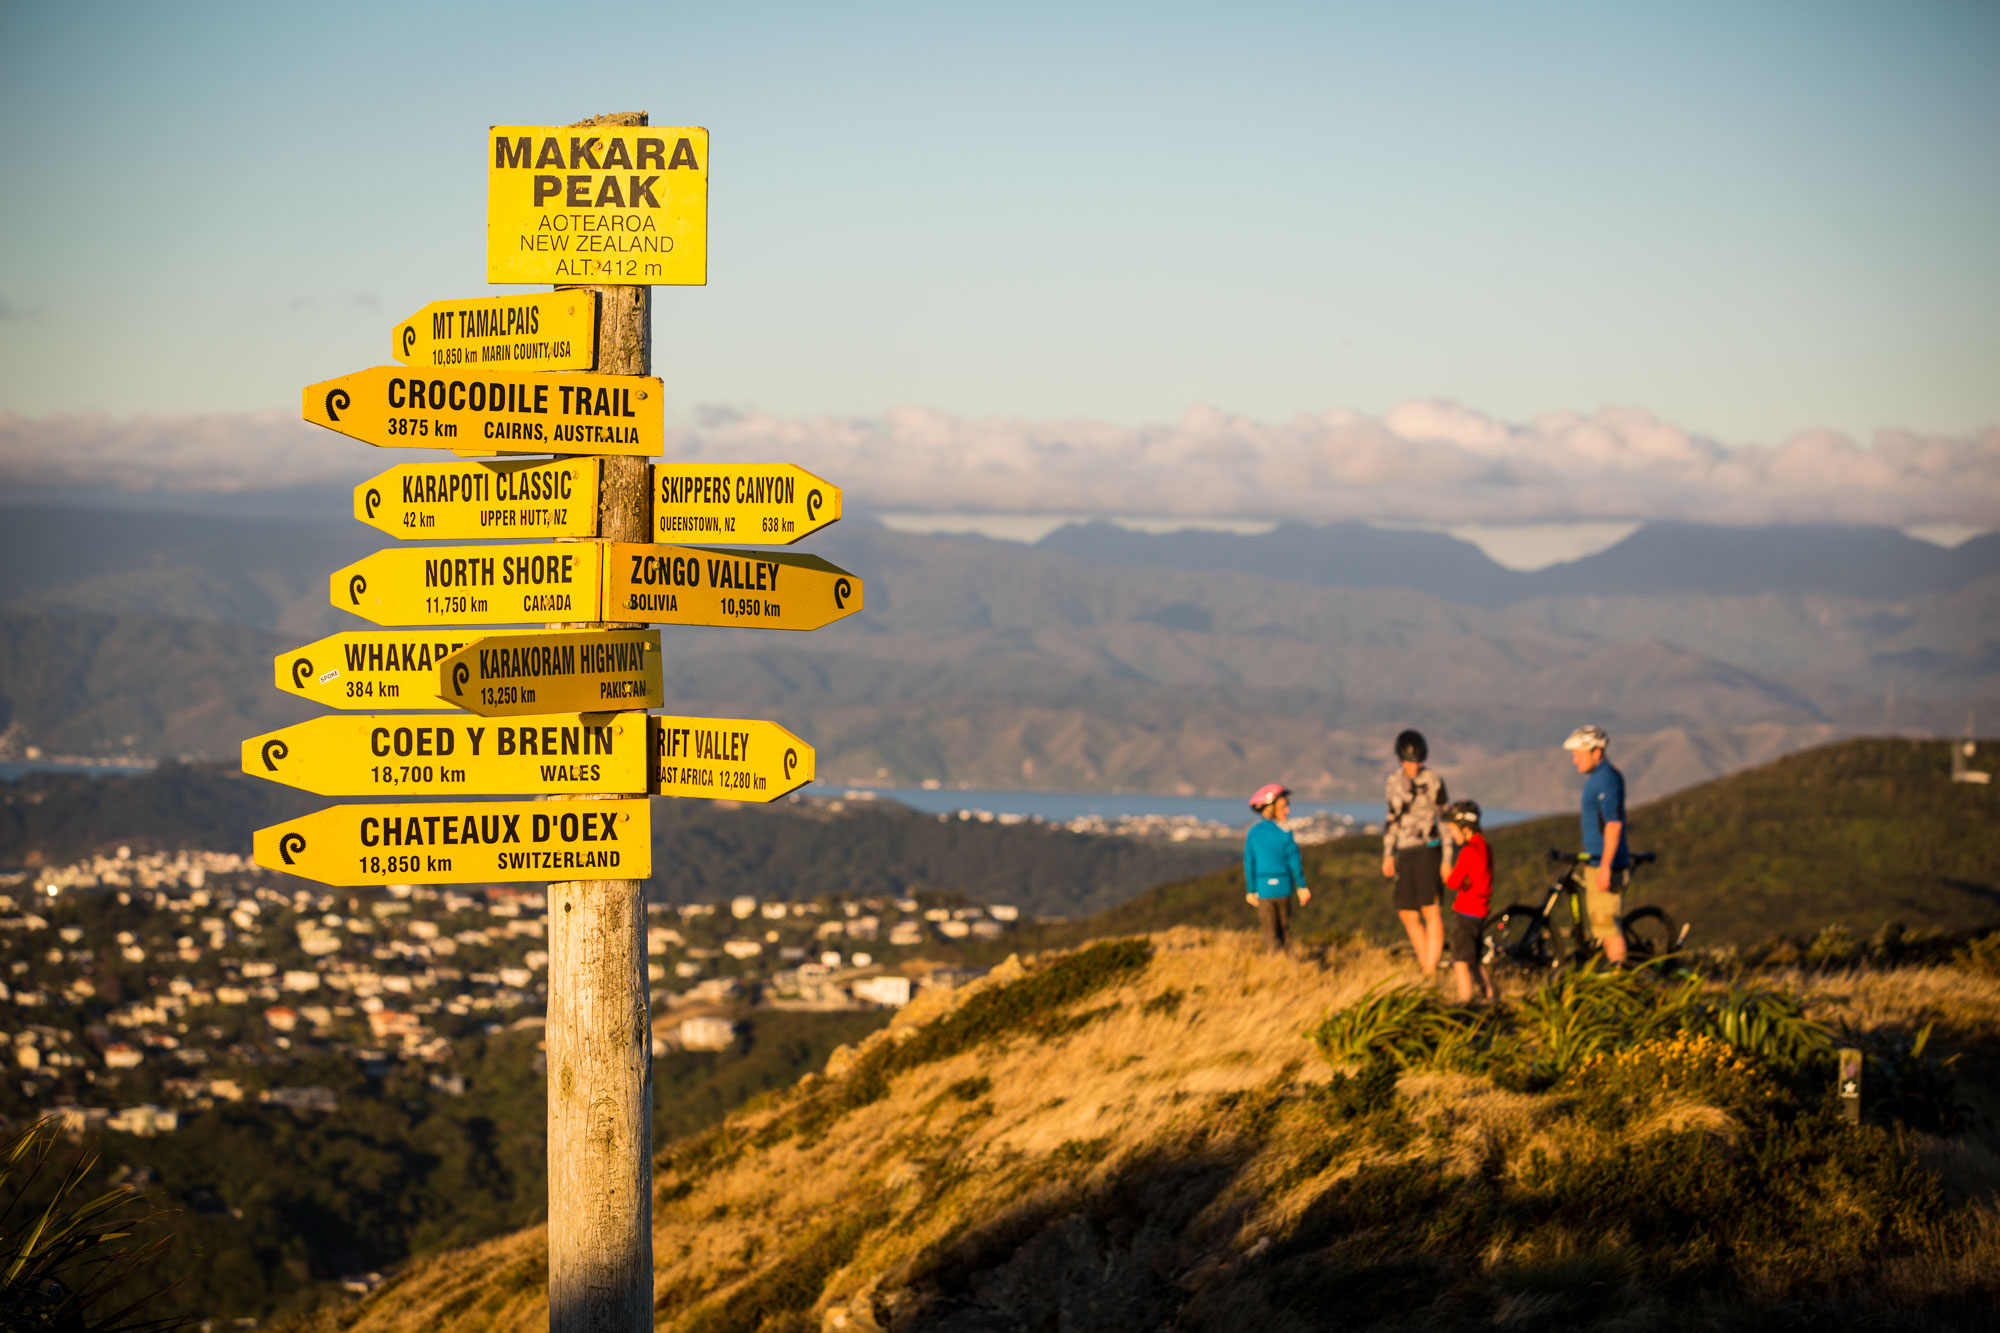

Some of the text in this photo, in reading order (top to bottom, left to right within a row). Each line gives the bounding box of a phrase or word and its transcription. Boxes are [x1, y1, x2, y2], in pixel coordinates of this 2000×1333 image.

[496, 137, 699, 170] MAKARA
[534, 175, 661, 208] PEAK
[538, 215, 656, 231] AOTEAROA
[521, 235, 674, 252] NEW ZEALAND
[556, 259, 661, 276] ALT. 412 m
[433, 306, 538, 339] MT TAMALPAIS
[433, 341, 571, 367] 10,850 km MARIN COUNTY, USA
[388, 378, 635, 417] CROCODILE TRAIL
[388, 418, 639, 444] 3875 km CAIRNS, AUSTRALIA
[403, 471, 572, 503] KARAPOTI CLASSIC
[662, 476, 794, 504] SKIPPERS CANYON
[403, 512, 435, 527] 42 km
[481, 509, 567, 528] UPPER HUTT, NZ
[660, 517, 735, 534] QUEENSTOWN, NZ
[762, 517, 794, 532] 638 km
[426, 555, 572, 587] NORTH SHORE
[631, 555, 779, 591] ZONGO VALLEY
[426, 596, 487, 615] 11,750 km
[524, 594, 571, 611] CANADA
[630, 594, 677, 611] BOLIVIA
[721, 598, 780, 617] 10,950 km
[480, 642, 644, 679] KARAKORAM HIGHWAY
[321, 671, 338, 682] SPOKE
[347, 681, 399, 697] 384 km
[481, 686, 535, 708] 13,250 km
[601, 680, 646, 699] PAKISTAN
[371, 727, 613, 756] COED Y BRENIN
[657, 728, 749, 761] RIFT VALLEY
[371, 766, 465, 785] 18,700 km
[540, 764, 600, 782] WALES
[656, 766, 766, 790] EAST AFRICA 12,280 km
[360, 813, 618, 846] CHATEAUX D'OEX
[360, 856, 452, 875] 18,850 km
[498, 851, 620, 869] SWITZERLAND
